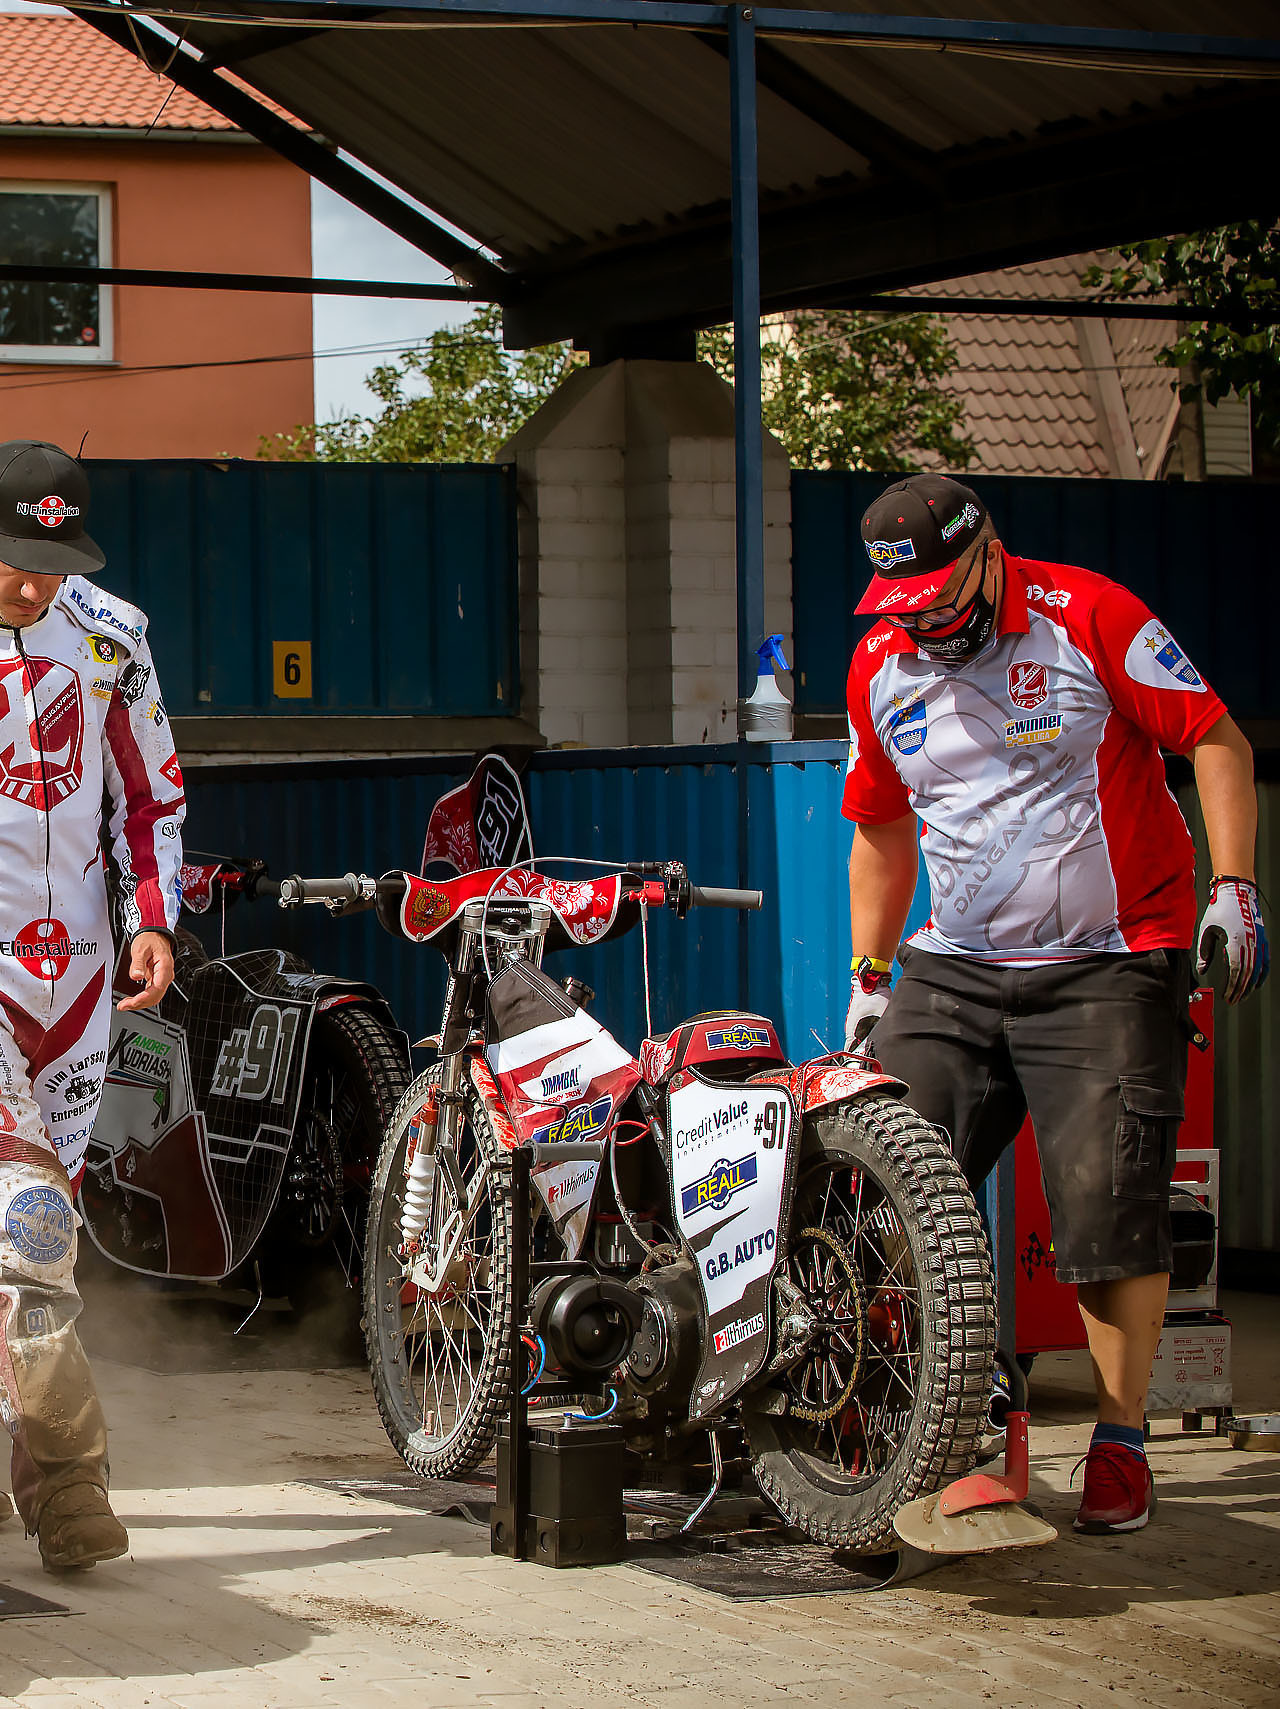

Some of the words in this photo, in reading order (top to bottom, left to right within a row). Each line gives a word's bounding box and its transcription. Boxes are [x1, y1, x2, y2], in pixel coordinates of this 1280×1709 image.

[69, 588, 128, 632] ResPro
[285, 653, 300, 685] 6
[40, 687, 77, 728] DAUGAVPILS
[0, 938, 98, 958] Elinstallation
[209, 1004, 301, 1105] #91
[722, 1030, 762, 1044] REALL
[44, 1070, 69, 1094] Jim
[754, 1101, 787, 1150] #91
[696, 1166, 746, 1205] REALL
[706, 1251, 734, 1281] G.B.
[734, 1229, 776, 1268] AUTO
[1214, 1365, 1223, 1376] Pb
